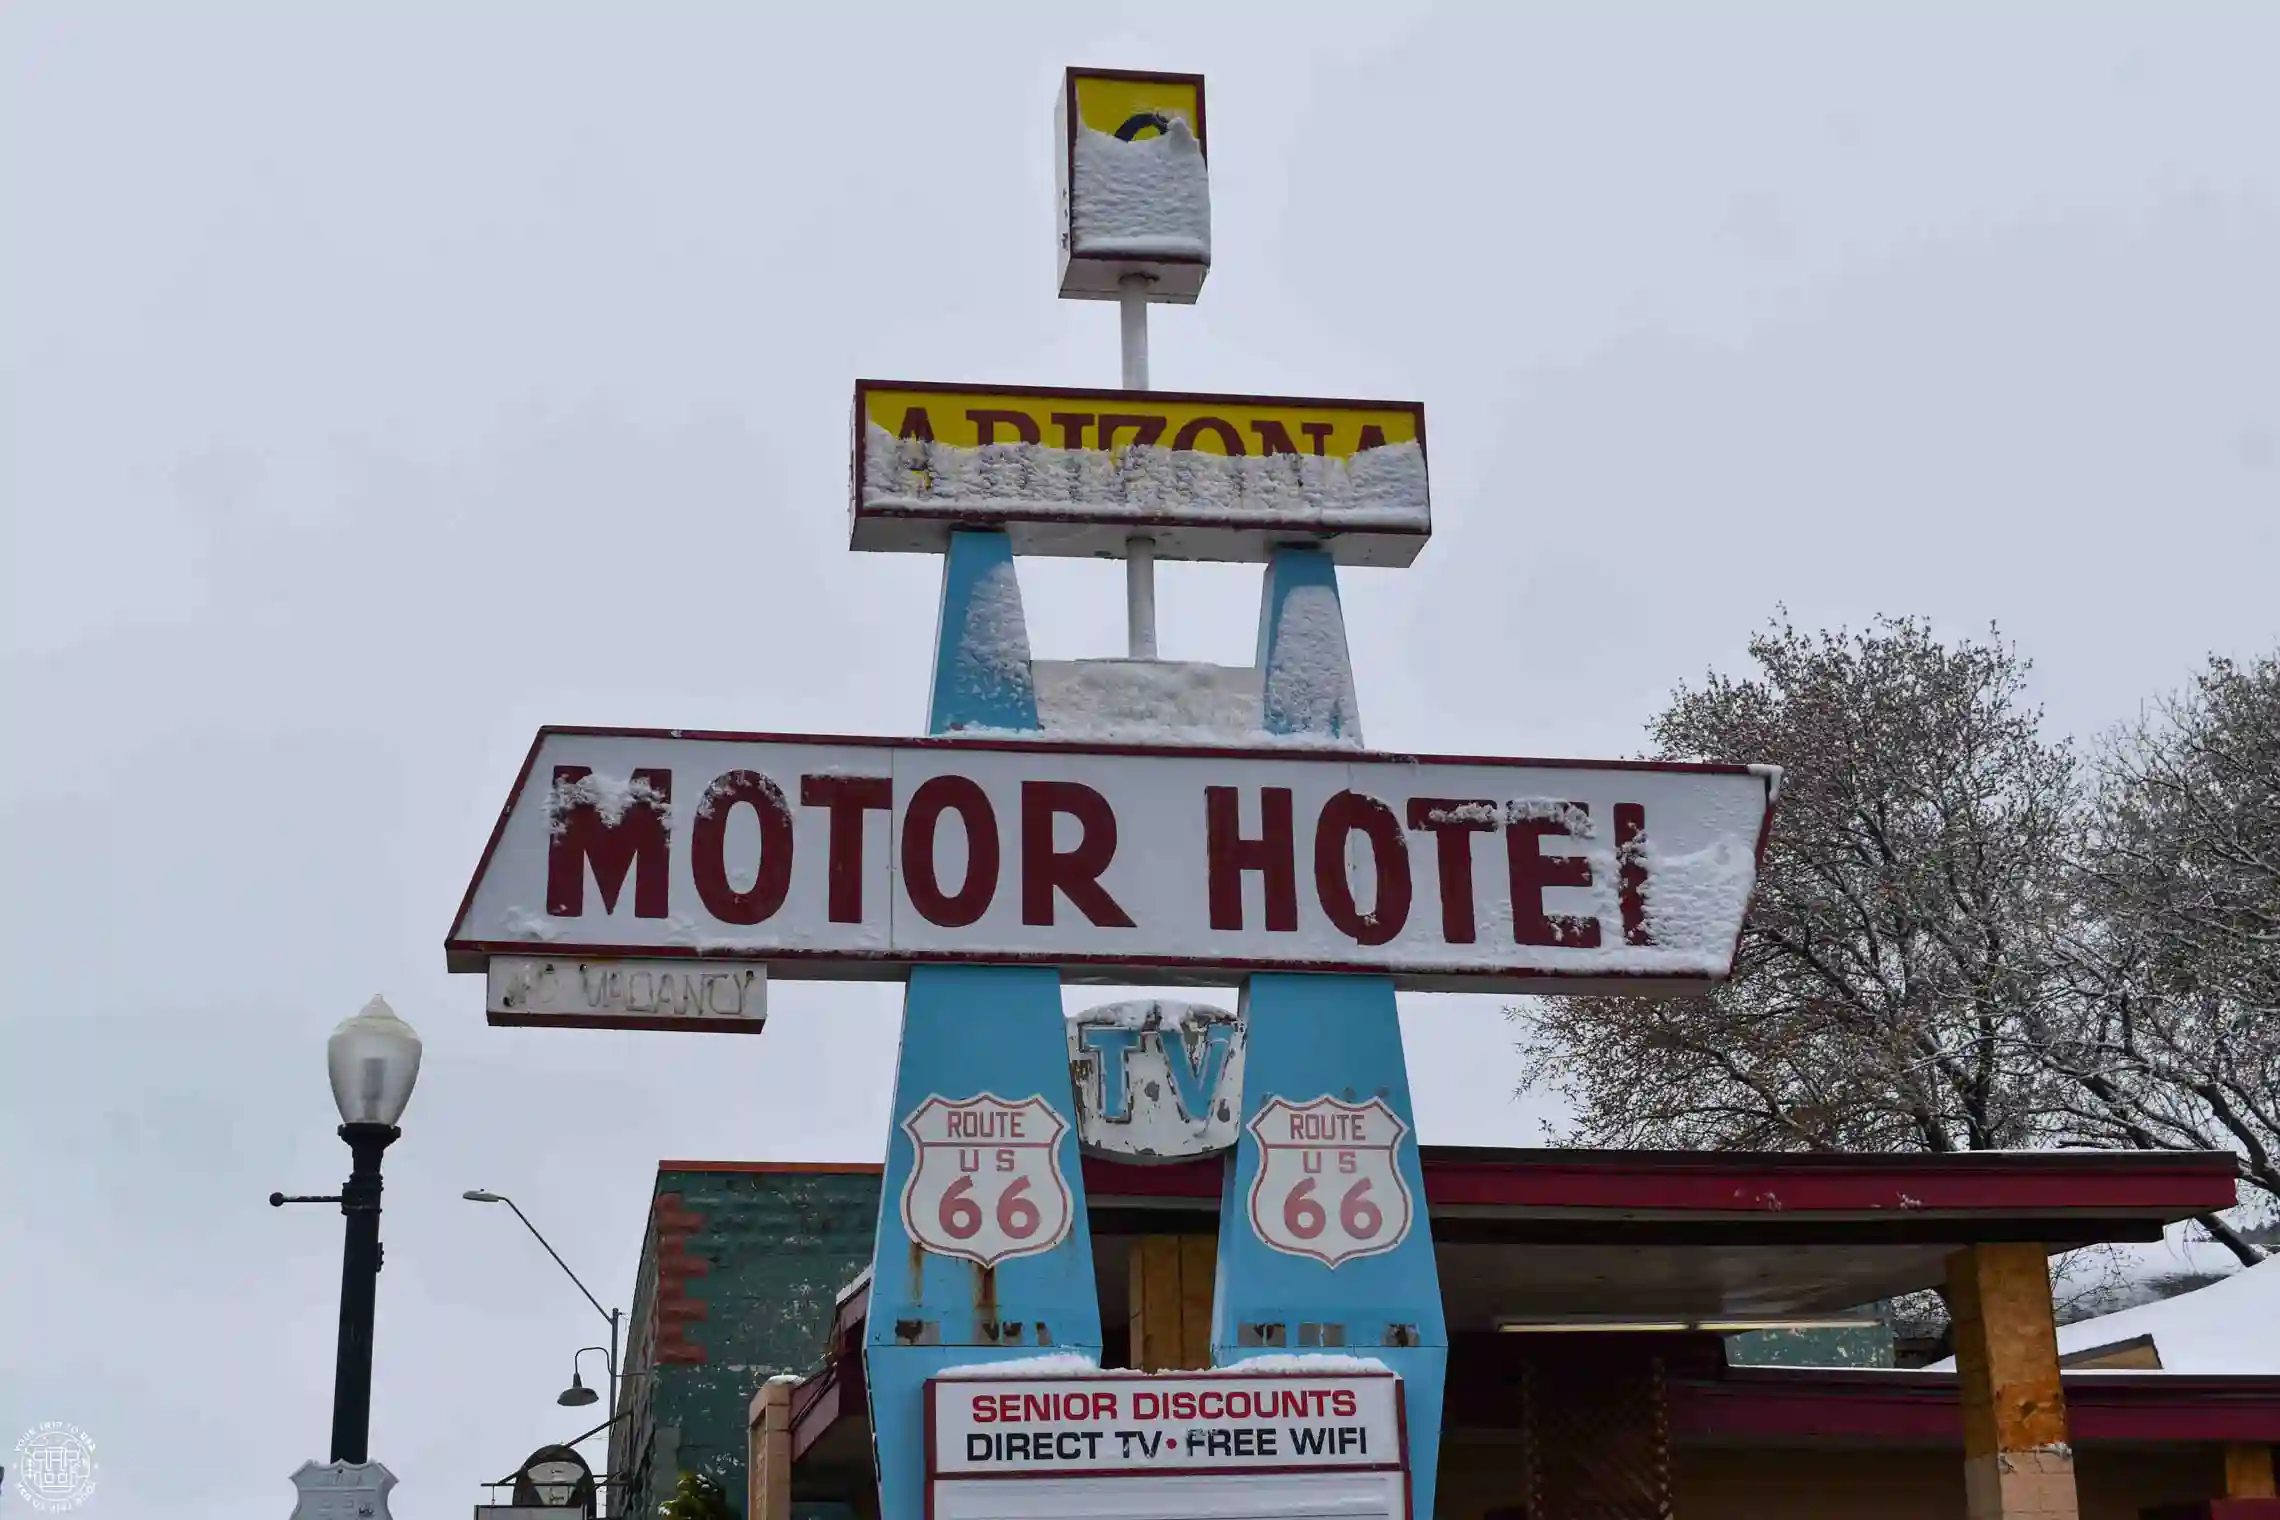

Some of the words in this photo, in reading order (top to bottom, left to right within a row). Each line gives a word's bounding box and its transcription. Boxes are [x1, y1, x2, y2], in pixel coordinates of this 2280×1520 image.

[545, 765, 1138, 928] MOTOR
[1080, 1021, 1235, 1123] TV
[947, 1111, 1026, 1139] ROUTE
[1289, 1113, 1367, 1142] ROUTE
[938, 1174, 1041, 1240] 66
[1283, 1176, 1384, 1240] 66
[971, 1393, 1118, 1423] SENIOR
[1132, 1389, 1358, 1420] DISCOUNTS
[966, 1431, 1103, 1461] DIRECT
[1186, 1427, 1278, 1458] FREE
[1289, 1425, 1368, 1456] WIFI
